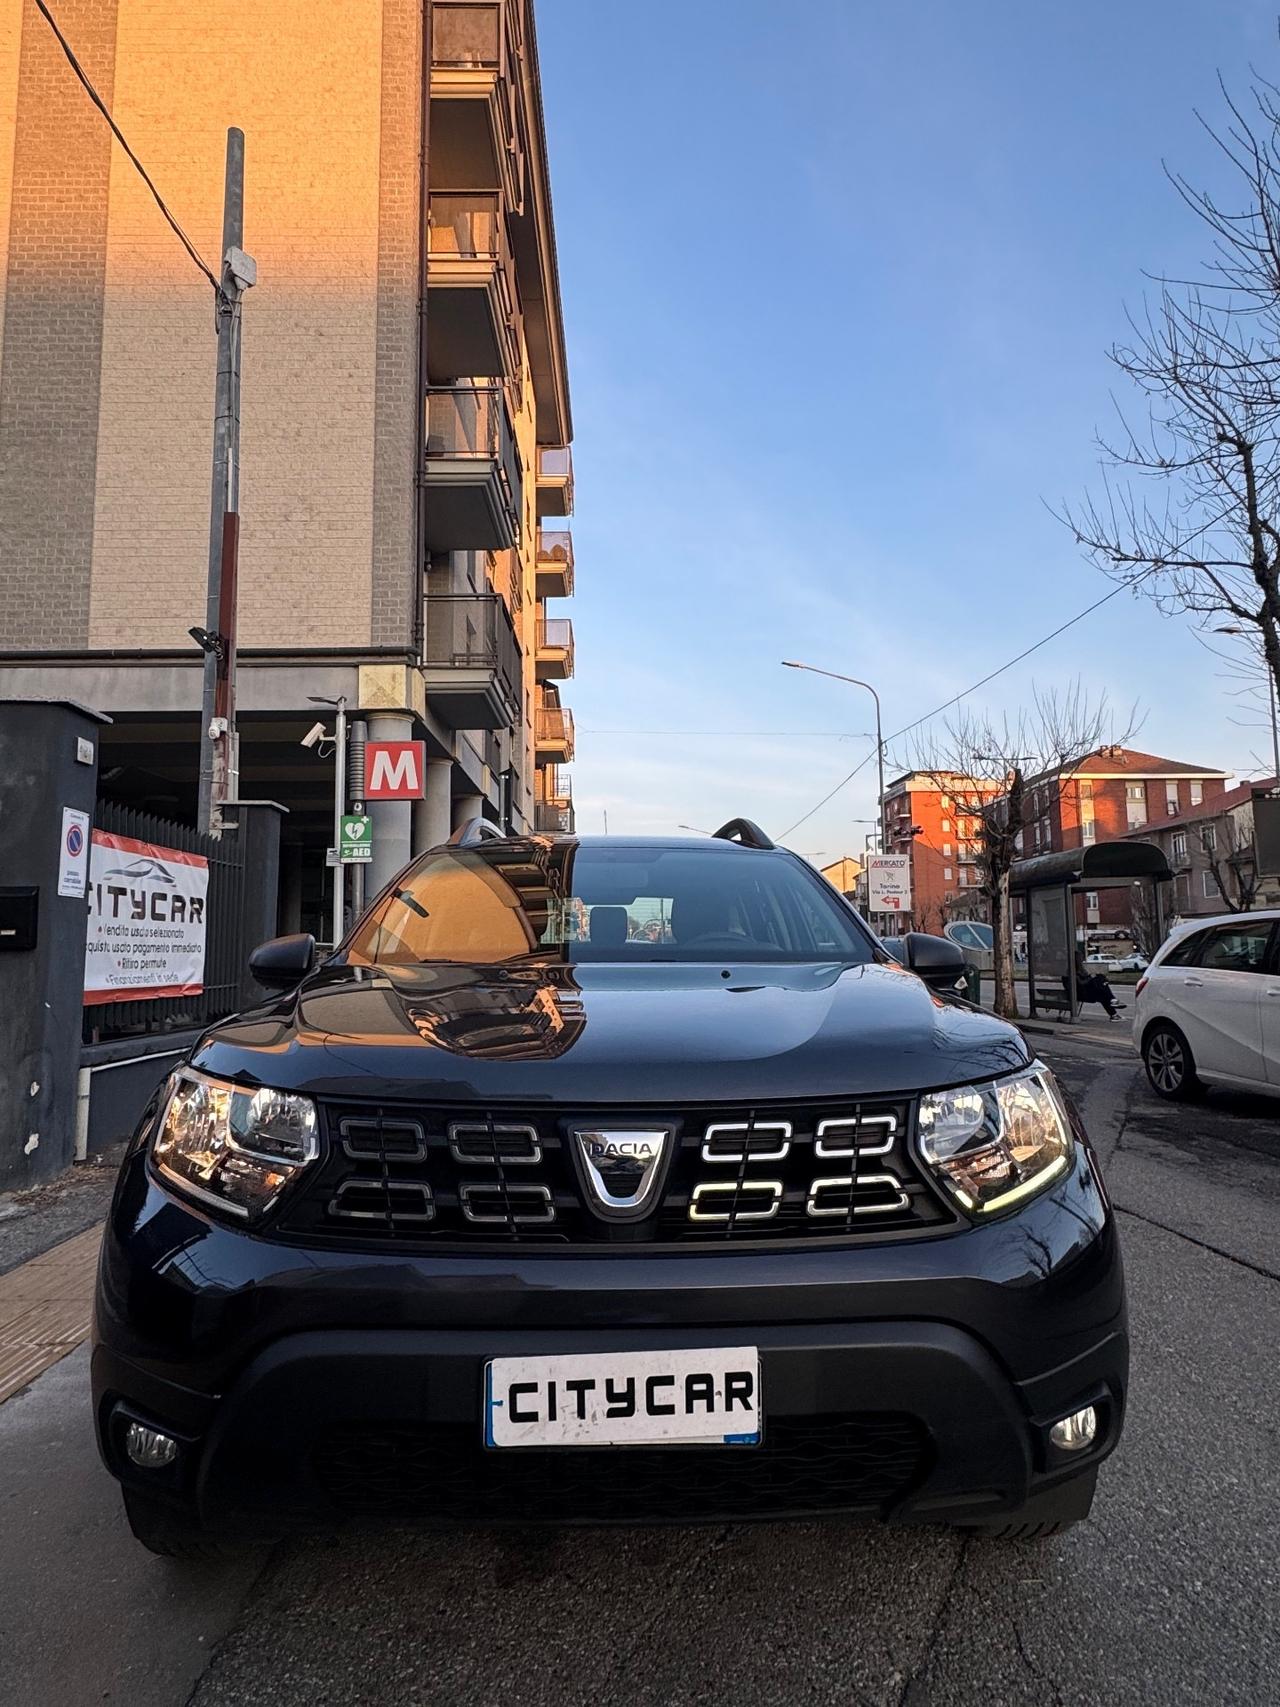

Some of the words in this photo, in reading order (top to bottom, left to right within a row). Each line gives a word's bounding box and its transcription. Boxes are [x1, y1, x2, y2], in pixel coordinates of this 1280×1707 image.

[370, 750, 418, 790] M
[352, 848, 371, 857] AED
[104, 924, 129, 937] Vendita
[130, 926, 149, 937] usato
[150, 928, 184, 938] selezionato
[111, 942, 131, 953] usato
[132, 943, 169, 956] pagamento
[171, 942, 202, 953] immediato
[122, 957, 139, 969] Ritiro
[140, 957, 167, 969] permute
[591, 1142, 652, 1155] DACIA
[508, 1371, 754, 1423] CITYCAR
